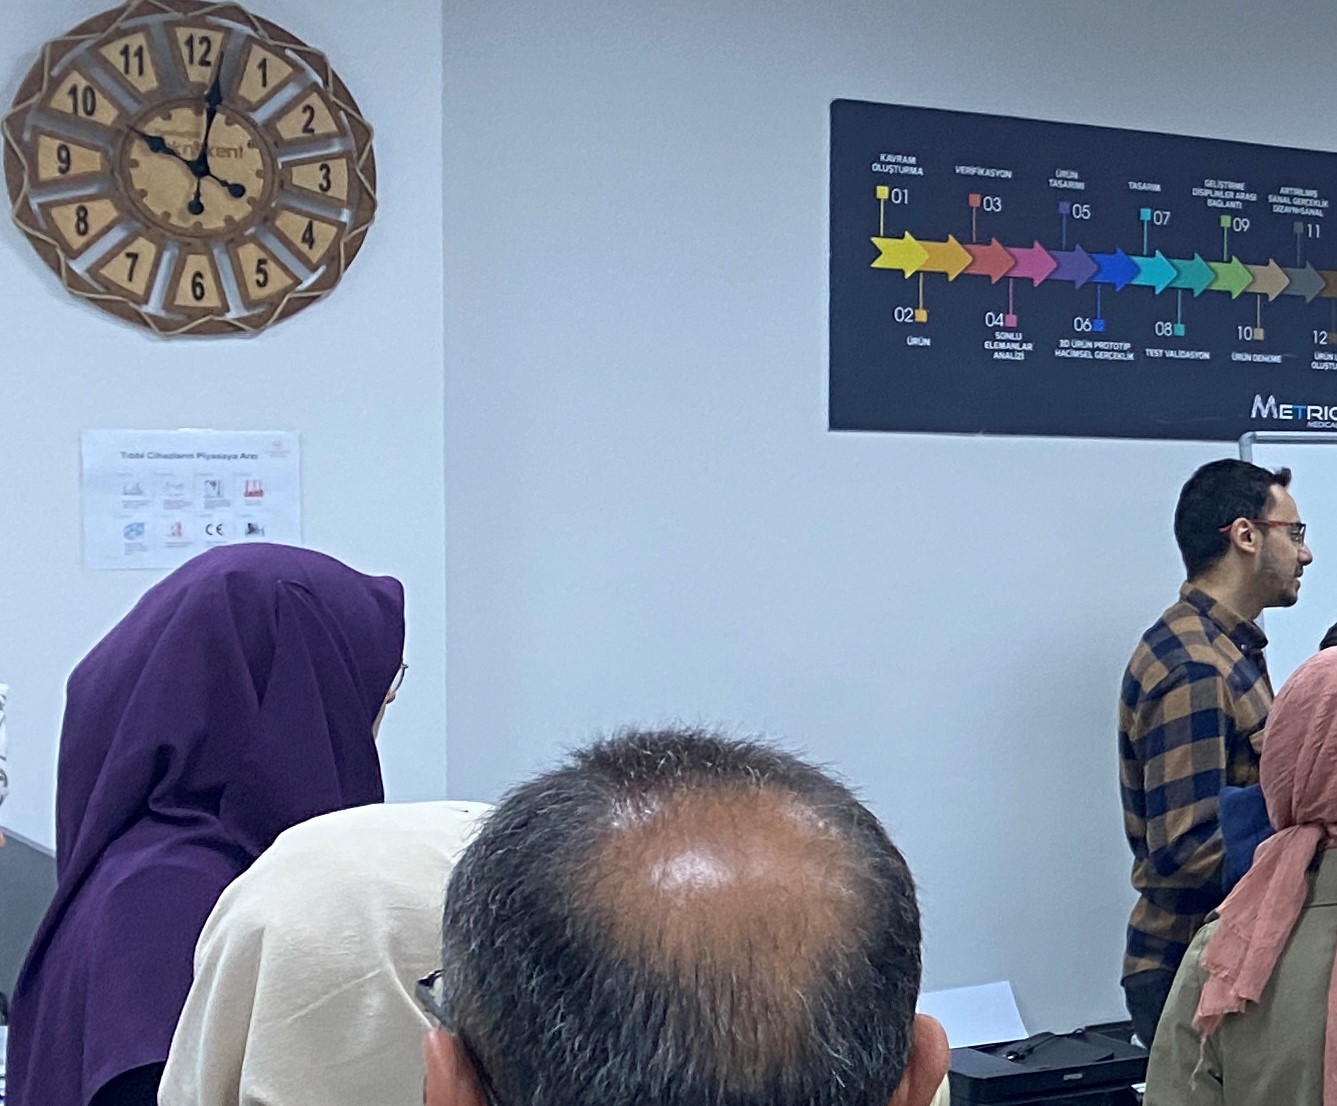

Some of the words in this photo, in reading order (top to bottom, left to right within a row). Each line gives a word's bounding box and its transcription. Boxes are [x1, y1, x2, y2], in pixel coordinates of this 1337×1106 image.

[184, 33, 213, 67] 12
[119, 44, 145, 77] 11
[256, 57, 269, 88] 1
[67, 84, 97, 117] 10
[301, 104, 316, 133] 2
[56, 144, 71, 175] 9
[880, 154, 916, 164] KAVRAM
[872, 162, 924, 176] OLUŞTURMA
[318, 163, 332, 192] 3
[890, 188, 910, 204] 01
[982, 196, 1002, 212] 03
[74, 204, 90, 236] 8
[1072, 204, 1090, 220] 05
[1154, 210, 1170, 226] 07
[1232, 218, 1250, 232] 09
[1306, 224, 1320, 238] 11
[301, 219, 316, 250] 4
[124, 252, 139, 282] 7
[254, 258, 269, 288] 5
[190, 270, 205, 301] 6
[894, 306, 914, 322] 02
[984, 312, 1004, 328] 04
[1074, 316, 1092, 332] 06
[1154, 322, 1172, 336] 08
[906, 334, 930, 346] ÜRÜN
[994, 332, 1022, 340] SONLU
[1238, 326, 1252, 340] 10
[1312, 330, 1328, 344] 12
[984, 340, 1034, 350] ELEMANLAR
[1070, 338, 1092, 348] ÜRÜN
[992, 350, 1024, 360] ANALİZİ
[1144, 348, 1164, 358] TEST
[1164, 348, 1210, 360] VALİDASYON
[196, 452, 238, 461] Piyasaya
